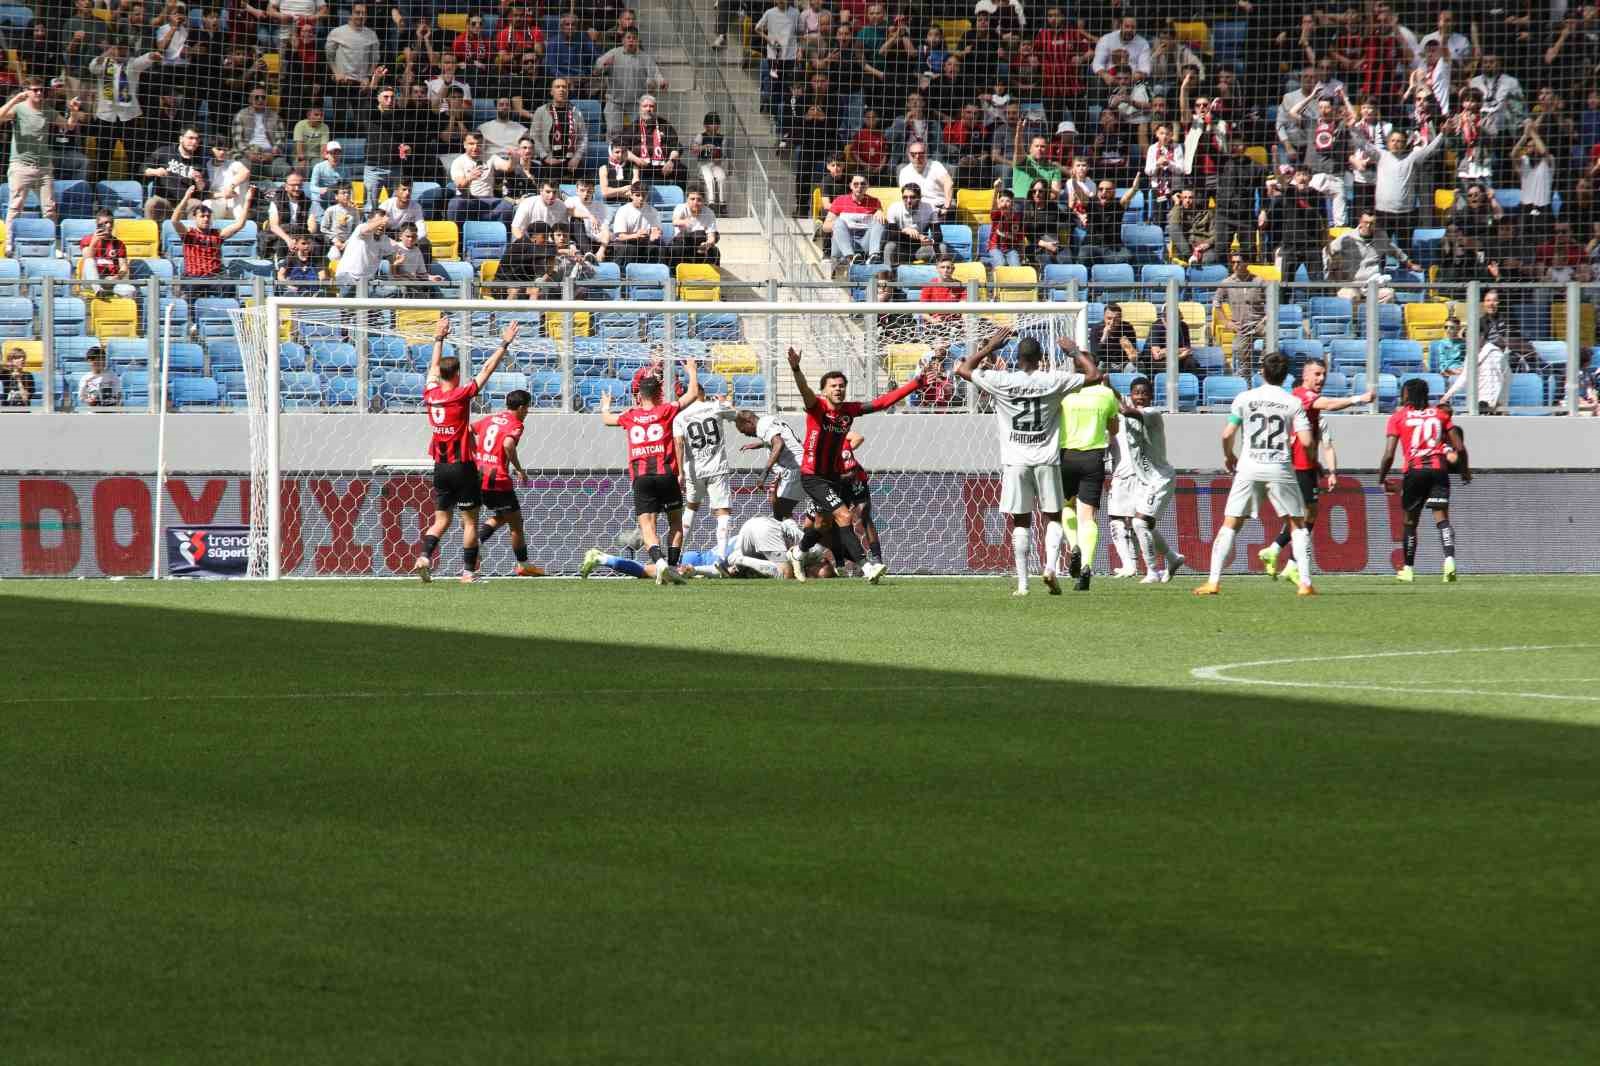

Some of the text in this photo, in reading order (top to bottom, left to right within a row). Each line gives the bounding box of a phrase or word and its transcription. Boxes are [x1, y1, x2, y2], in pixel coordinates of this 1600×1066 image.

[1010, 397, 1043, 431] 21
[483, 424, 499, 453] 8
[687, 416, 721, 449] 99
[1250, 413, 1285, 450] 22
[1405, 417, 1441, 448] 70
